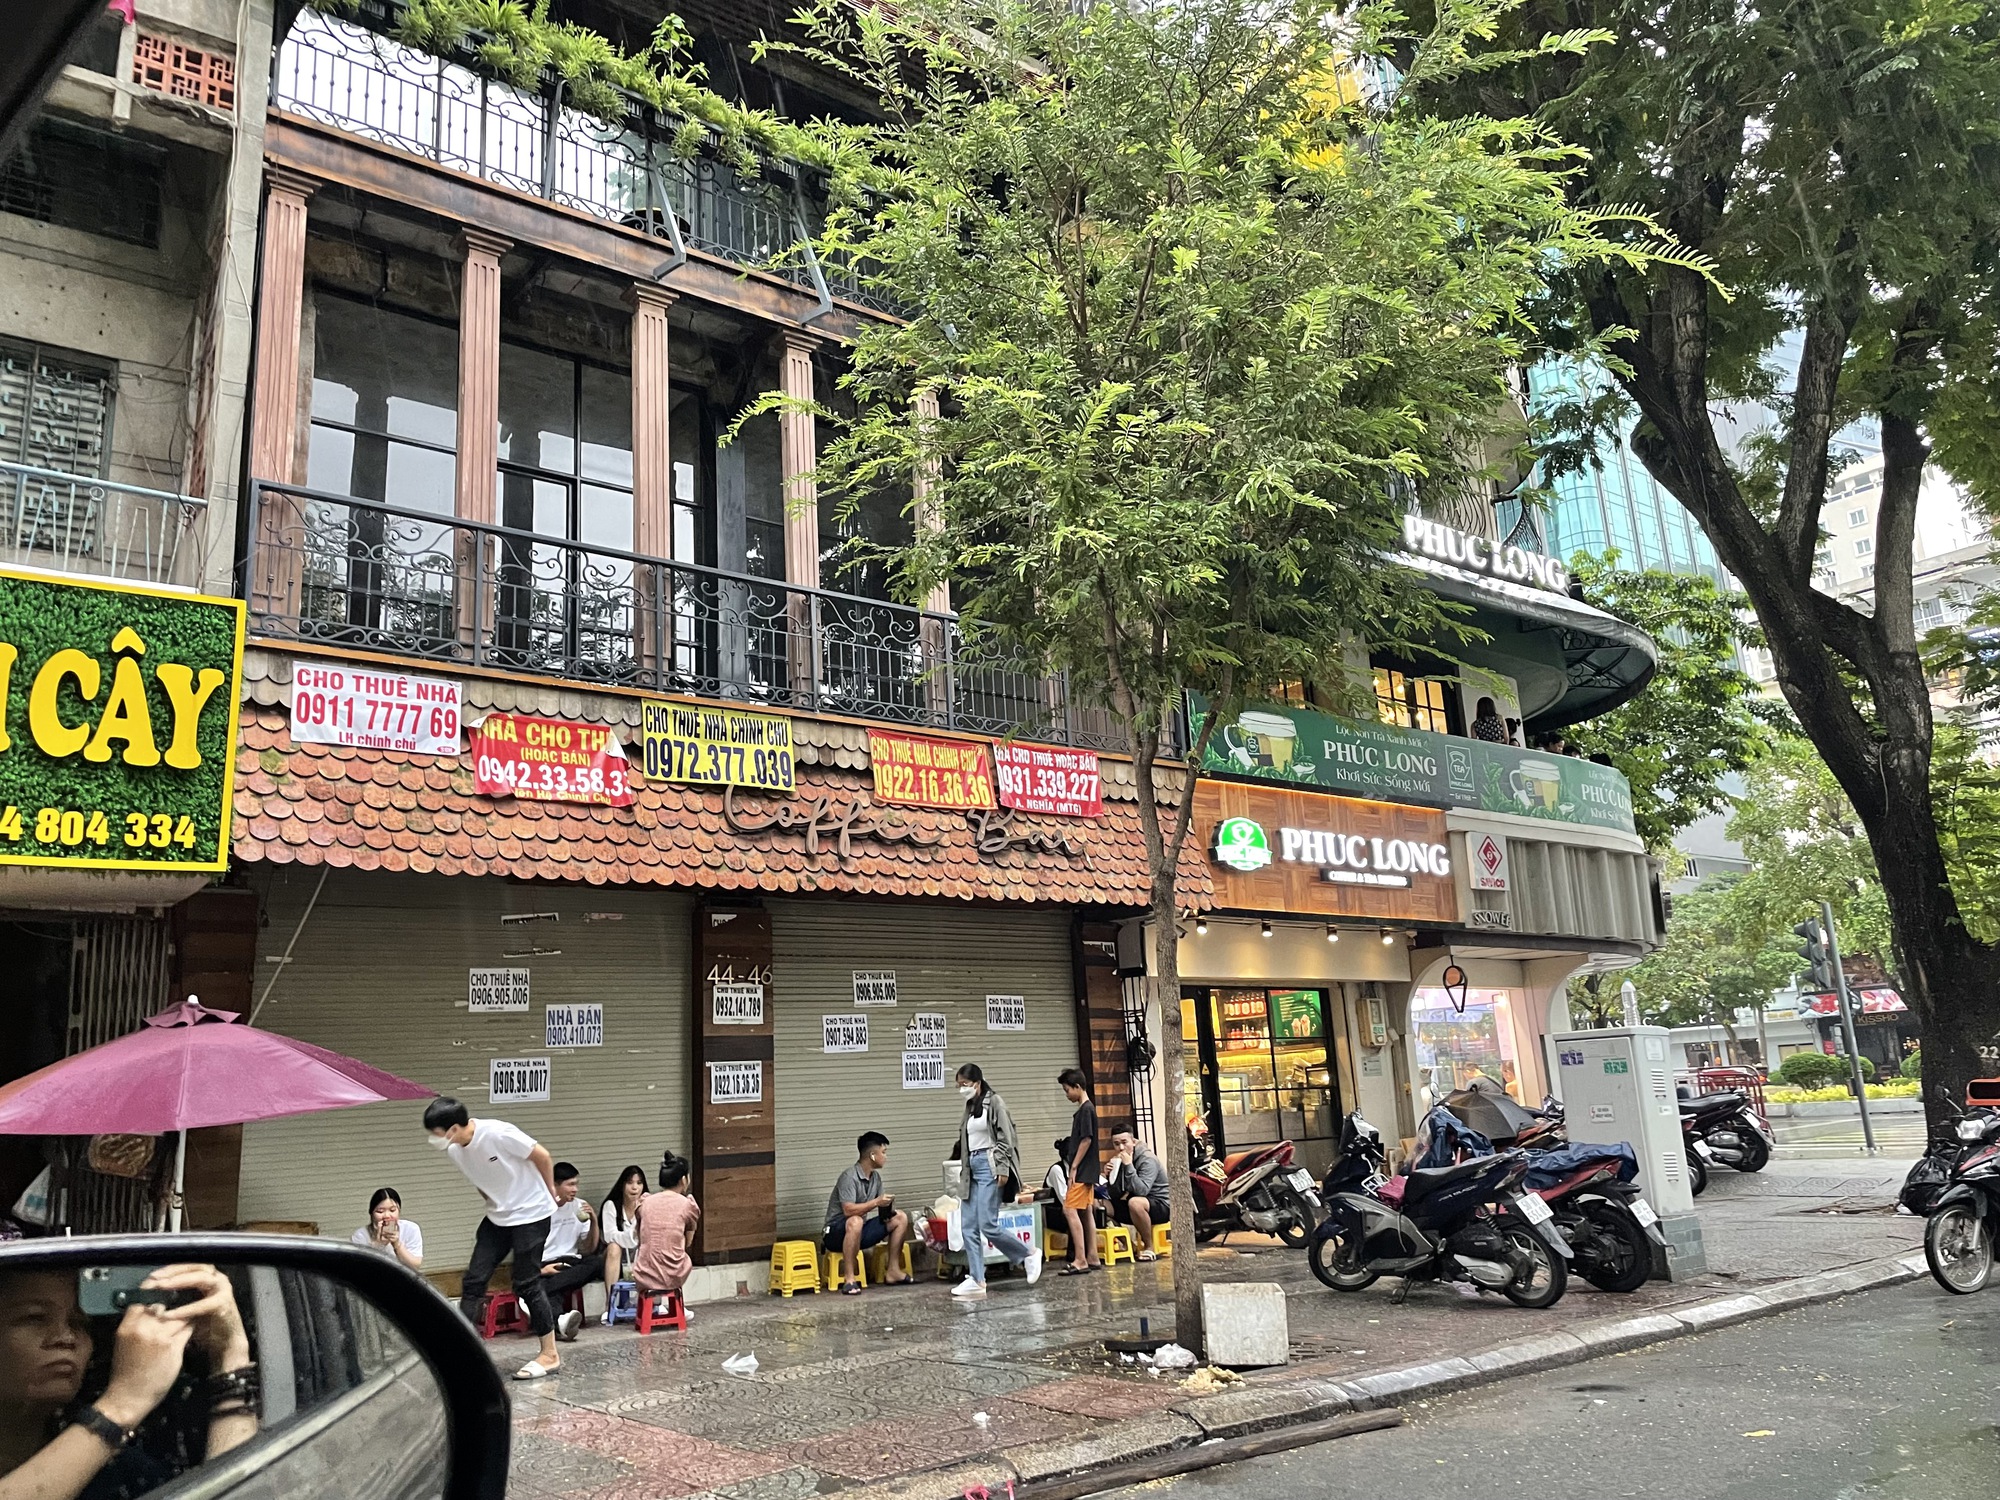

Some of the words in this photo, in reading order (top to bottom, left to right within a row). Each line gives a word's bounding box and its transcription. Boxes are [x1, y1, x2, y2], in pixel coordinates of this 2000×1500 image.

[1403, 514, 1487, 570] PHUC
[1491, 541, 1566, 590] LONG
[29, 626, 225, 769] CÂY
[297, 668, 343, 690] CHO
[352, 677, 408, 698] THUÊ
[416, 683, 457, 704] NHÀ
[296, 691, 354, 728] 0911
[366, 699, 422, 735] 7777
[430, 707, 457, 739] 69
[645, 705, 668, 734] CHO
[672, 706, 700, 739] THUÊ
[703, 710, 727, 742] NHÀ
[730, 712, 764, 745] CHÍNH
[766, 717, 788, 747] CHỦ
[338, 732, 353, 744] LH
[357, 733, 391, 748] chính
[395, 737, 416, 750] chủ
[526, 722, 571, 749] CHO
[1371, 731, 1385, 741] Trà
[1387, 733, 1407, 746] Xanh
[521, 747, 558, 765] (HOẶC
[562, 750, 591, 767] BÁN)
[870, 736, 890, 761] CHO
[890, 738, 914, 764] THUÊ
[913, 740, 933, 767] NHÀ
[933, 743, 960, 770] CHÍNH
[1012, 747, 1030, 765] CHO
[1031, 750, 1054, 767] THUÊ
[1054, 752, 1077, 772] HOẶC
[1078, 753, 1096, 772] BÁN
[1323, 739, 1379, 767] PHÚC
[1384, 750, 1437, 776] LONG
[1336, 767, 1360, 782] Khơi
[1362, 771, 1382, 785] Sức
[1385, 773, 1411, 793] Sống
[1413, 779, 1431, 793] Mới
[1453, 764, 1465, 774] TEA
[873, 762, 991, 806] 0922.16.36.36
[996, 763, 1099, 802] 0931.339.227
[1026, 799, 1054, 811] NGHĨA
[1056, 803, 1082, 816] (MTG)
[35, 808, 109, 846] 804
[124, 812, 196, 849] 334
[723, 784, 947, 858] Coffee
[1280, 826, 1366, 869] PHUC
[1372, 838, 1450, 876] LONG
[471, 973, 488, 987] CHO
[489, 969, 511, 986] THUÊ
[512, 968, 529, 986] NHÀ
[471, 987, 528, 1005] 0906.905.006
[715, 996, 761, 1017] 0932.141.789
[547, 1005, 573, 1026] NHÀ
[577, 1005, 602, 1025] BÁN
[1857, 1013, 1899, 1024] KISSHO
[547, 1026, 602, 1046] 0903.410.073
[496, 1061, 512, 1069] CHO
[513, 1059, 531, 1067] THUÊ
[532, 1058, 546, 1067] NHÀ
[494, 1069, 548, 1094] 0906.98.0017
